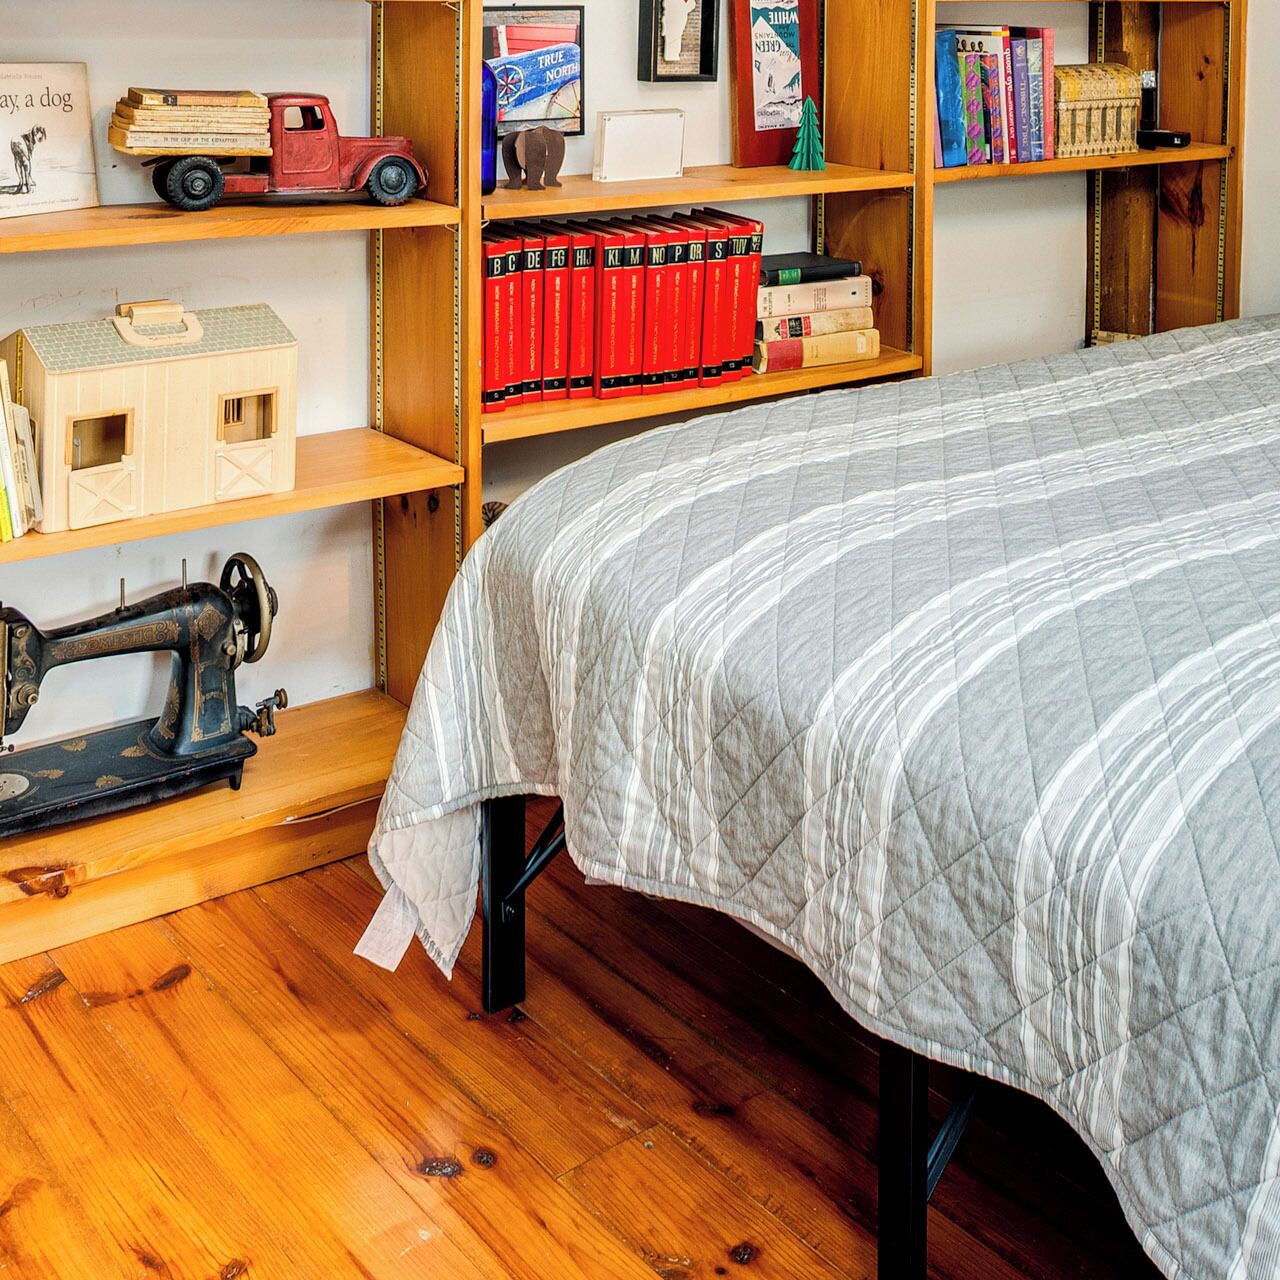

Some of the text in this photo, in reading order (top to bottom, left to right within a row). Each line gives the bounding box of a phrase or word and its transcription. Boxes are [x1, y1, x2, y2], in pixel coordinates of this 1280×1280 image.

[768, 12, 798, 24] WHITE
[755, 40, 780, 52] GREEN
[538, 51, 564, 68] TRUE
[546, 63, 578, 82] NORTH
[25, 94, 34, 107] a
[40, 87, 73, 112] dog
[675, 246, 682, 261] P
[690, 245, 701, 260] QR
[715, 243, 722, 259] S
[732, 237, 746, 254] TUV
[508, 253, 516, 270] C
[527, 250, 540, 268] DE
[552, 249, 565, 266] FG
[576, 248, 591, 265] HIJ
[609, 247, 619, 265] KL
[631, 248, 639, 263] M
[653, 247, 665, 263] NO
[493, 259, 501, 274] B
